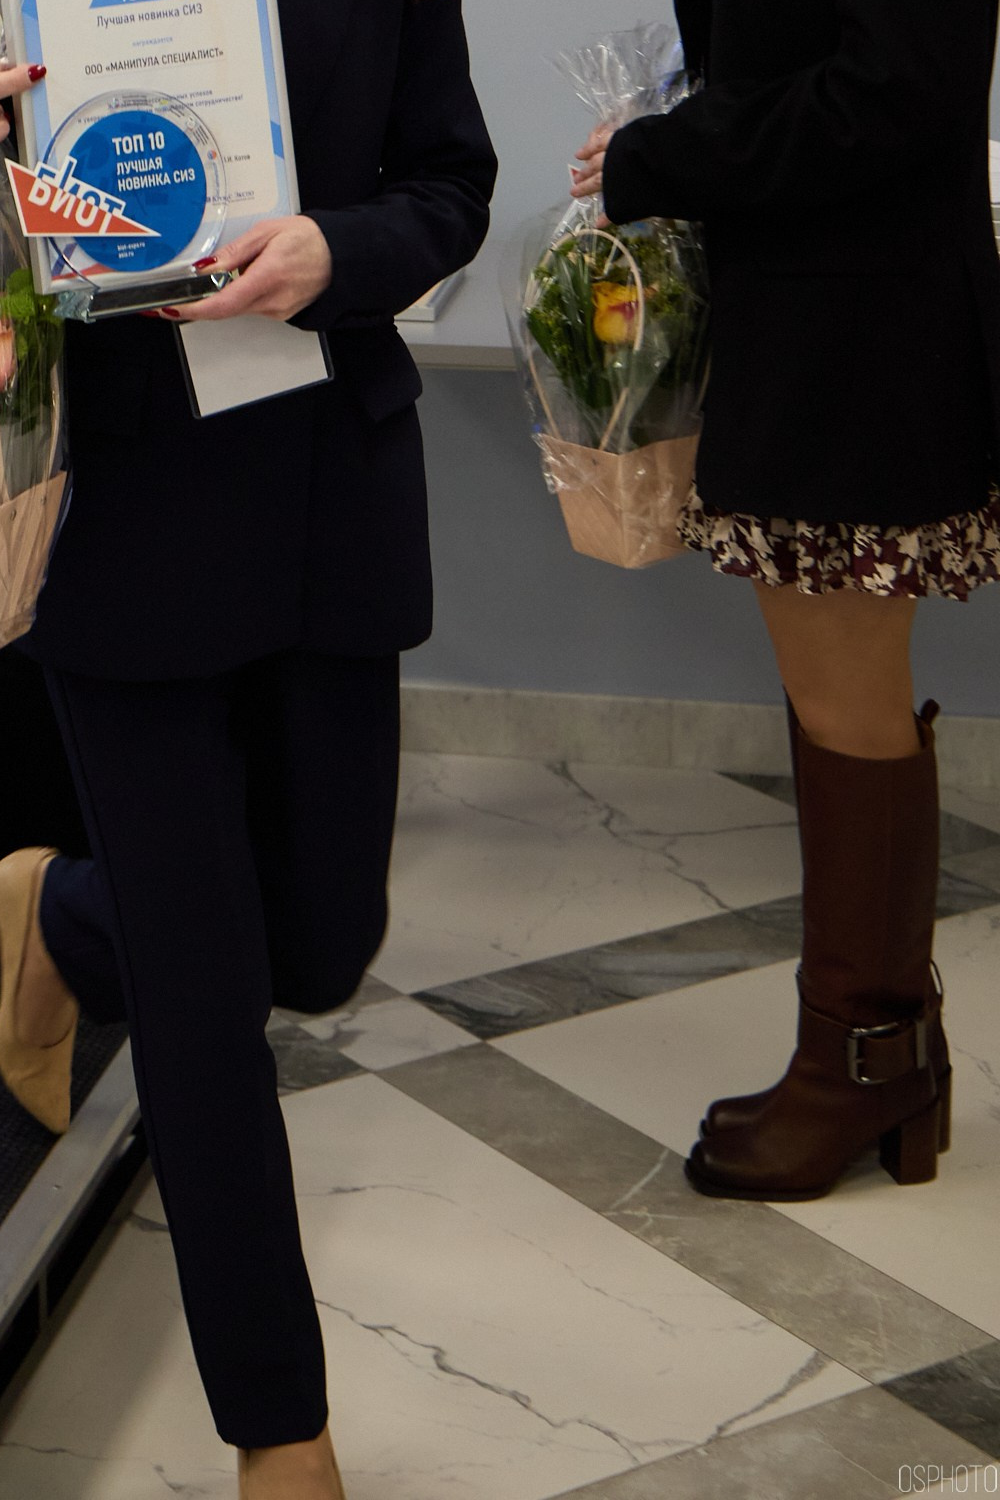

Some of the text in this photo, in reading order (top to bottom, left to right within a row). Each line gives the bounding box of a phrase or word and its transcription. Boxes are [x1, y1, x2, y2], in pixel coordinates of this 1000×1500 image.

[96, 3, 203, 29] Лучшая новинка СИЗ
[84, 47, 224, 76] ООО «МАНИПУЛА СПЕЦИАЛИСТ»
[112, 131, 165, 156] ТОП 10
[116, 156, 163, 176] ЛУЧШАЯ
[117, 173, 171, 192] НОВИНКА
[173, 167, 196, 184] СИЗ
[27, 159, 124, 235] БИОТ
